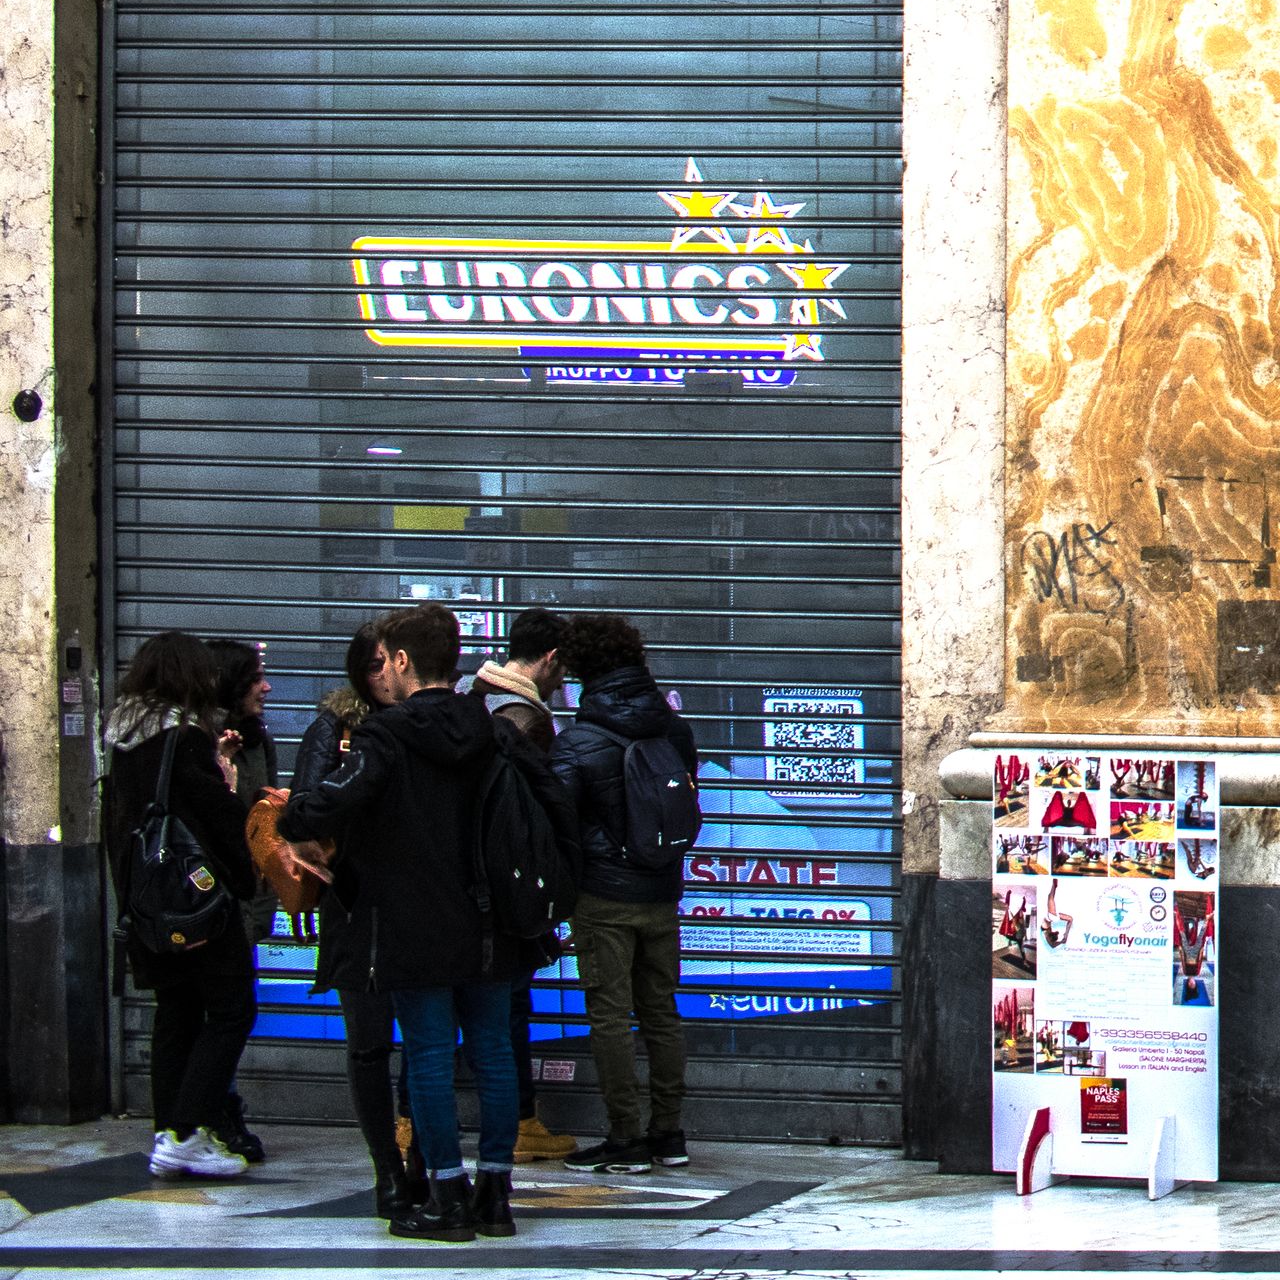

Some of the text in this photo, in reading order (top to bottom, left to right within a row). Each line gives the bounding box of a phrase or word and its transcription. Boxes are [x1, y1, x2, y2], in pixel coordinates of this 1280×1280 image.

[380, 261, 779, 325] EURONICS
[1083, 933, 1169, 948] Yogaflyonair
[1093, 1028, 1208, 1042] +393356558440
[1138, 1046, 1165, 1054] Umberto
[1184, 1048, 1206, 1056] Napoli
[1185, 1065, 1208, 1074] English
[1086, 1087, 1120, 1096] NAPLES
[1094, 1095, 1118, 1104] PASS
